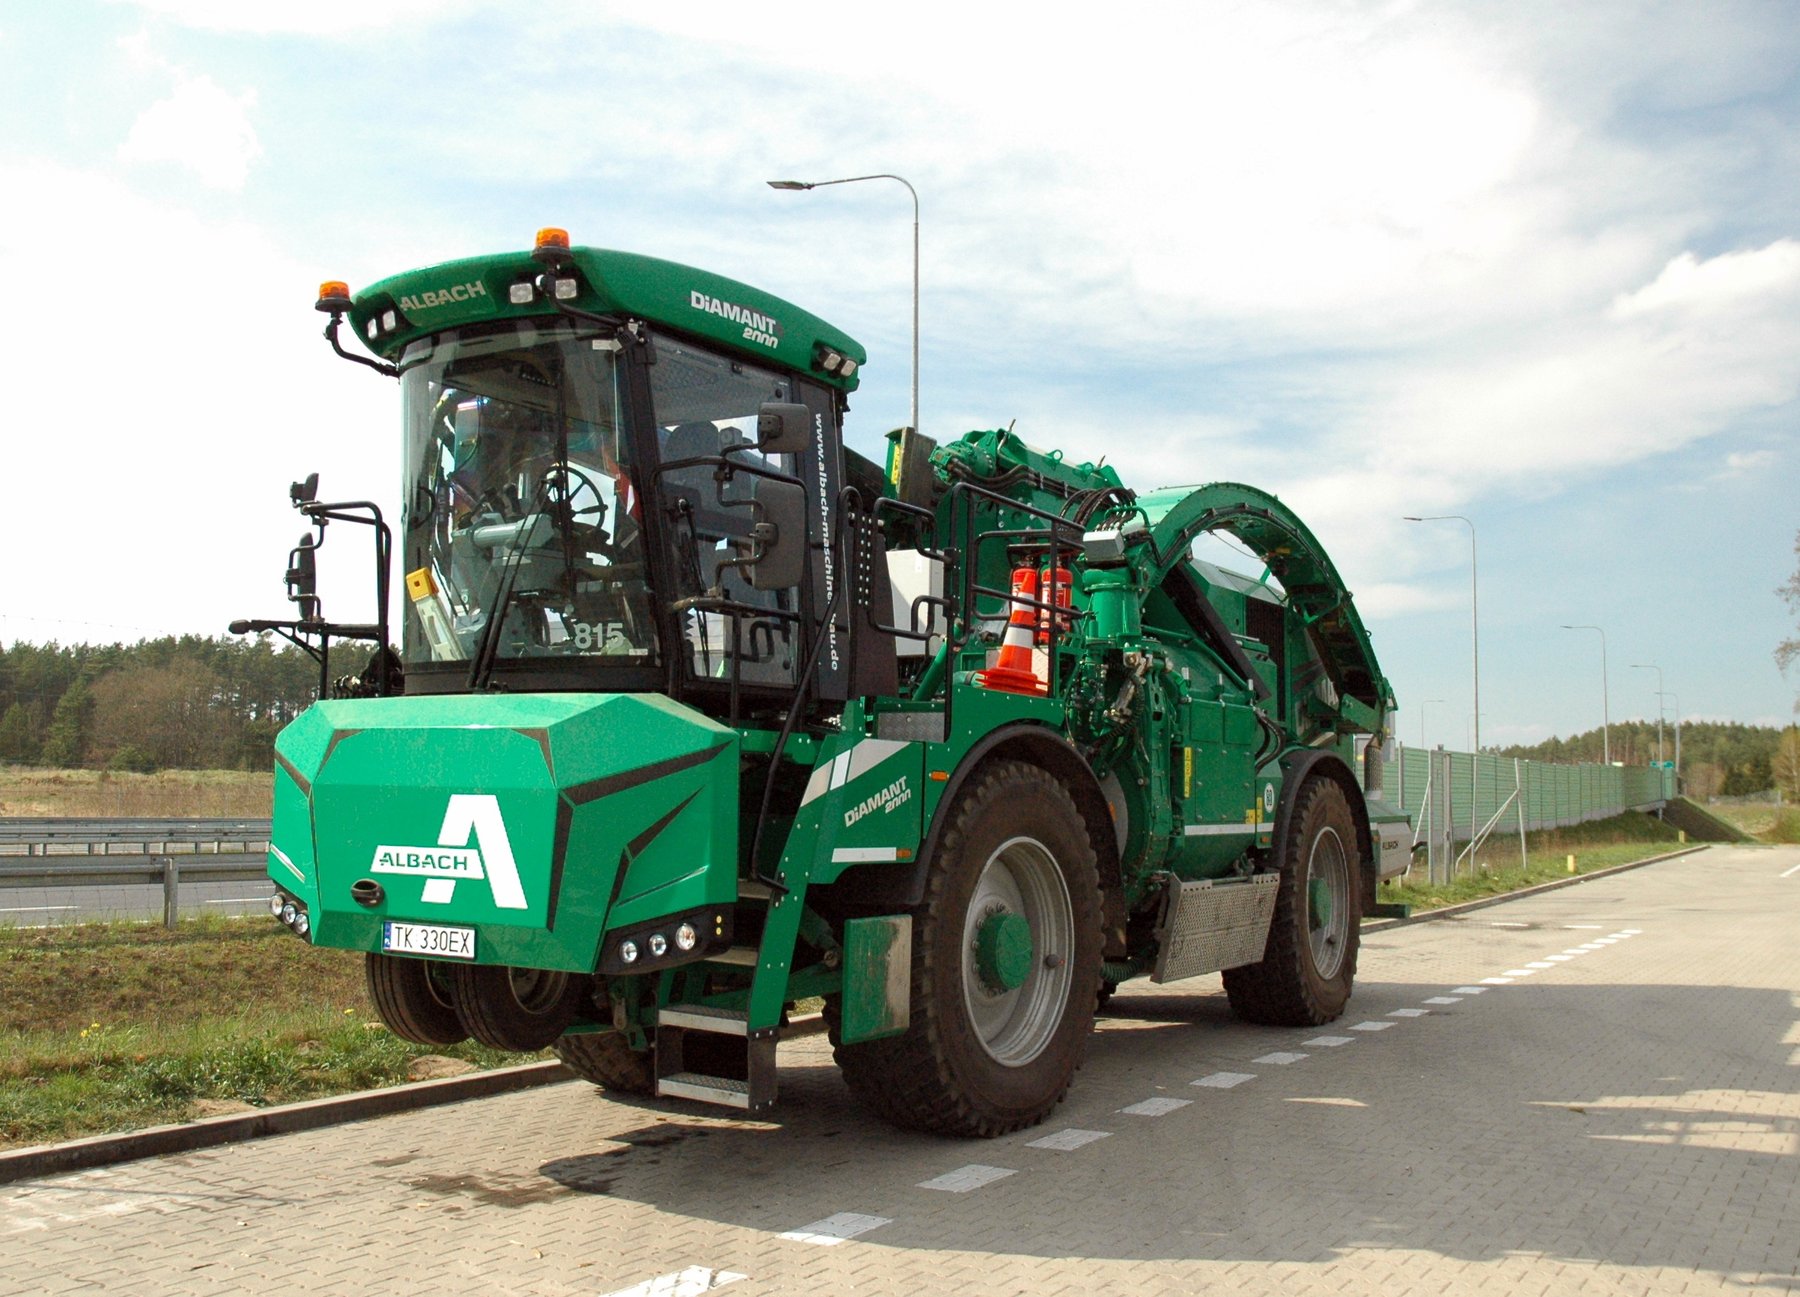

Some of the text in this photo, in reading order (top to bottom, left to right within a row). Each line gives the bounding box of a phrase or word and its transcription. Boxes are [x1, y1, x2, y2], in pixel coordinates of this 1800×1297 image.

[400, 280, 486, 311] ALBACH
[691, 290, 776, 335] DiAMANT
[574, 622, 625, 649] 815
[844, 775, 907, 827] DiAMANT
[379, 852, 468, 871] ALBACH
[394, 926, 470, 954] TK 330EX
